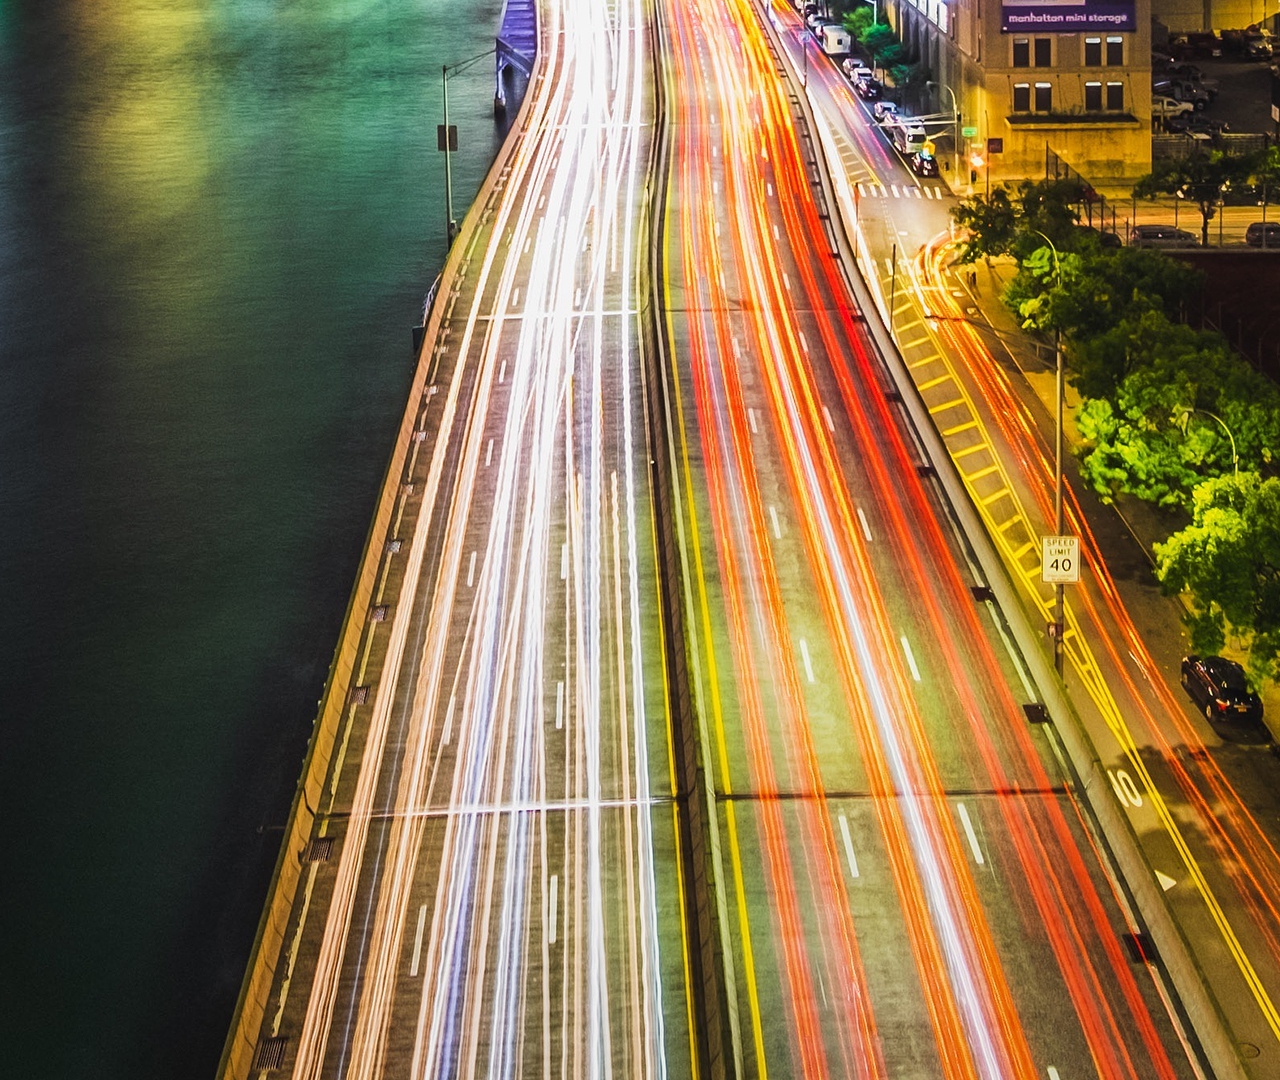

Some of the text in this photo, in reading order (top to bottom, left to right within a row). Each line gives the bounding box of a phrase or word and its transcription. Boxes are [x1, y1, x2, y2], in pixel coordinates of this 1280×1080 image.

[1008, 11, 1128, 24] manhattan mini storage
[1050, 558, 1071, 572] 40
